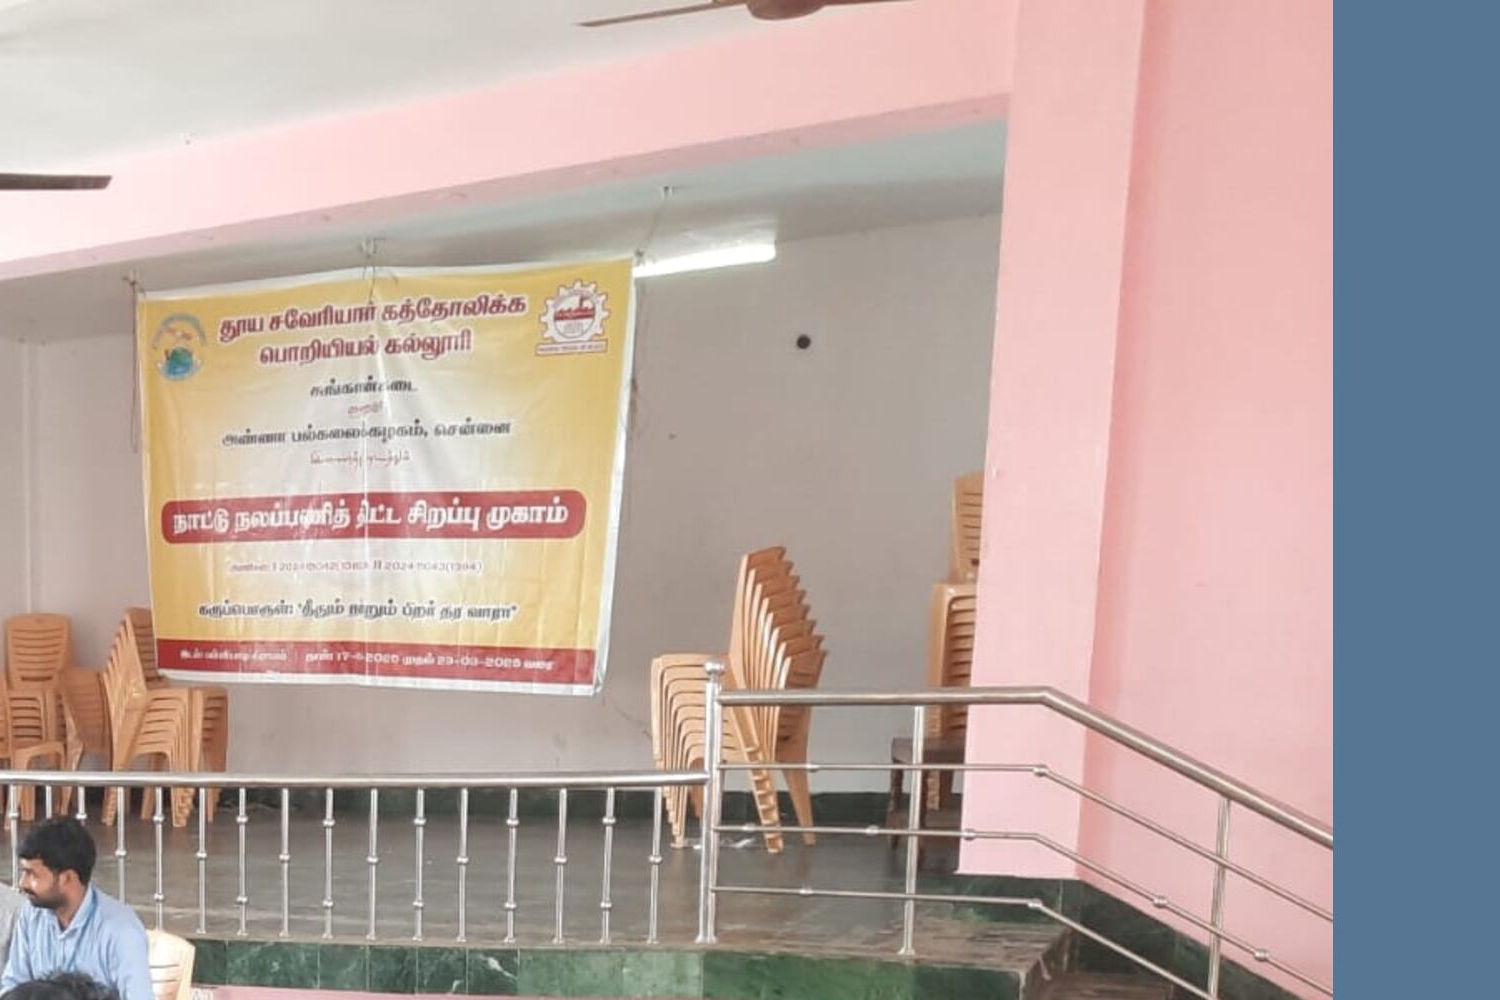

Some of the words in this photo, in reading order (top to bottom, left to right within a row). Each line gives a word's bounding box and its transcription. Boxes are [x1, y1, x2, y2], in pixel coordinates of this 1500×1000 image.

[219, 317, 264, 343] தூய
[269, 300, 378, 331] சவேரியார்
[381, 293, 527, 325] கத்தோலிக்க
[259, 334, 380, 366] பொறியியல்
[384, 329, 472, 359] கல்லூரி
[221, 427, 286, 447] அண்ணா
[433, 417, 511, 438] சென்னை
[173, 508, 230, 536] நாட்டு
[234, 498, 351, 533] நலப்பணித்
[407, 496, 481, 531] சிறப்பு
[486, 495, 569, 529] முகாம்
